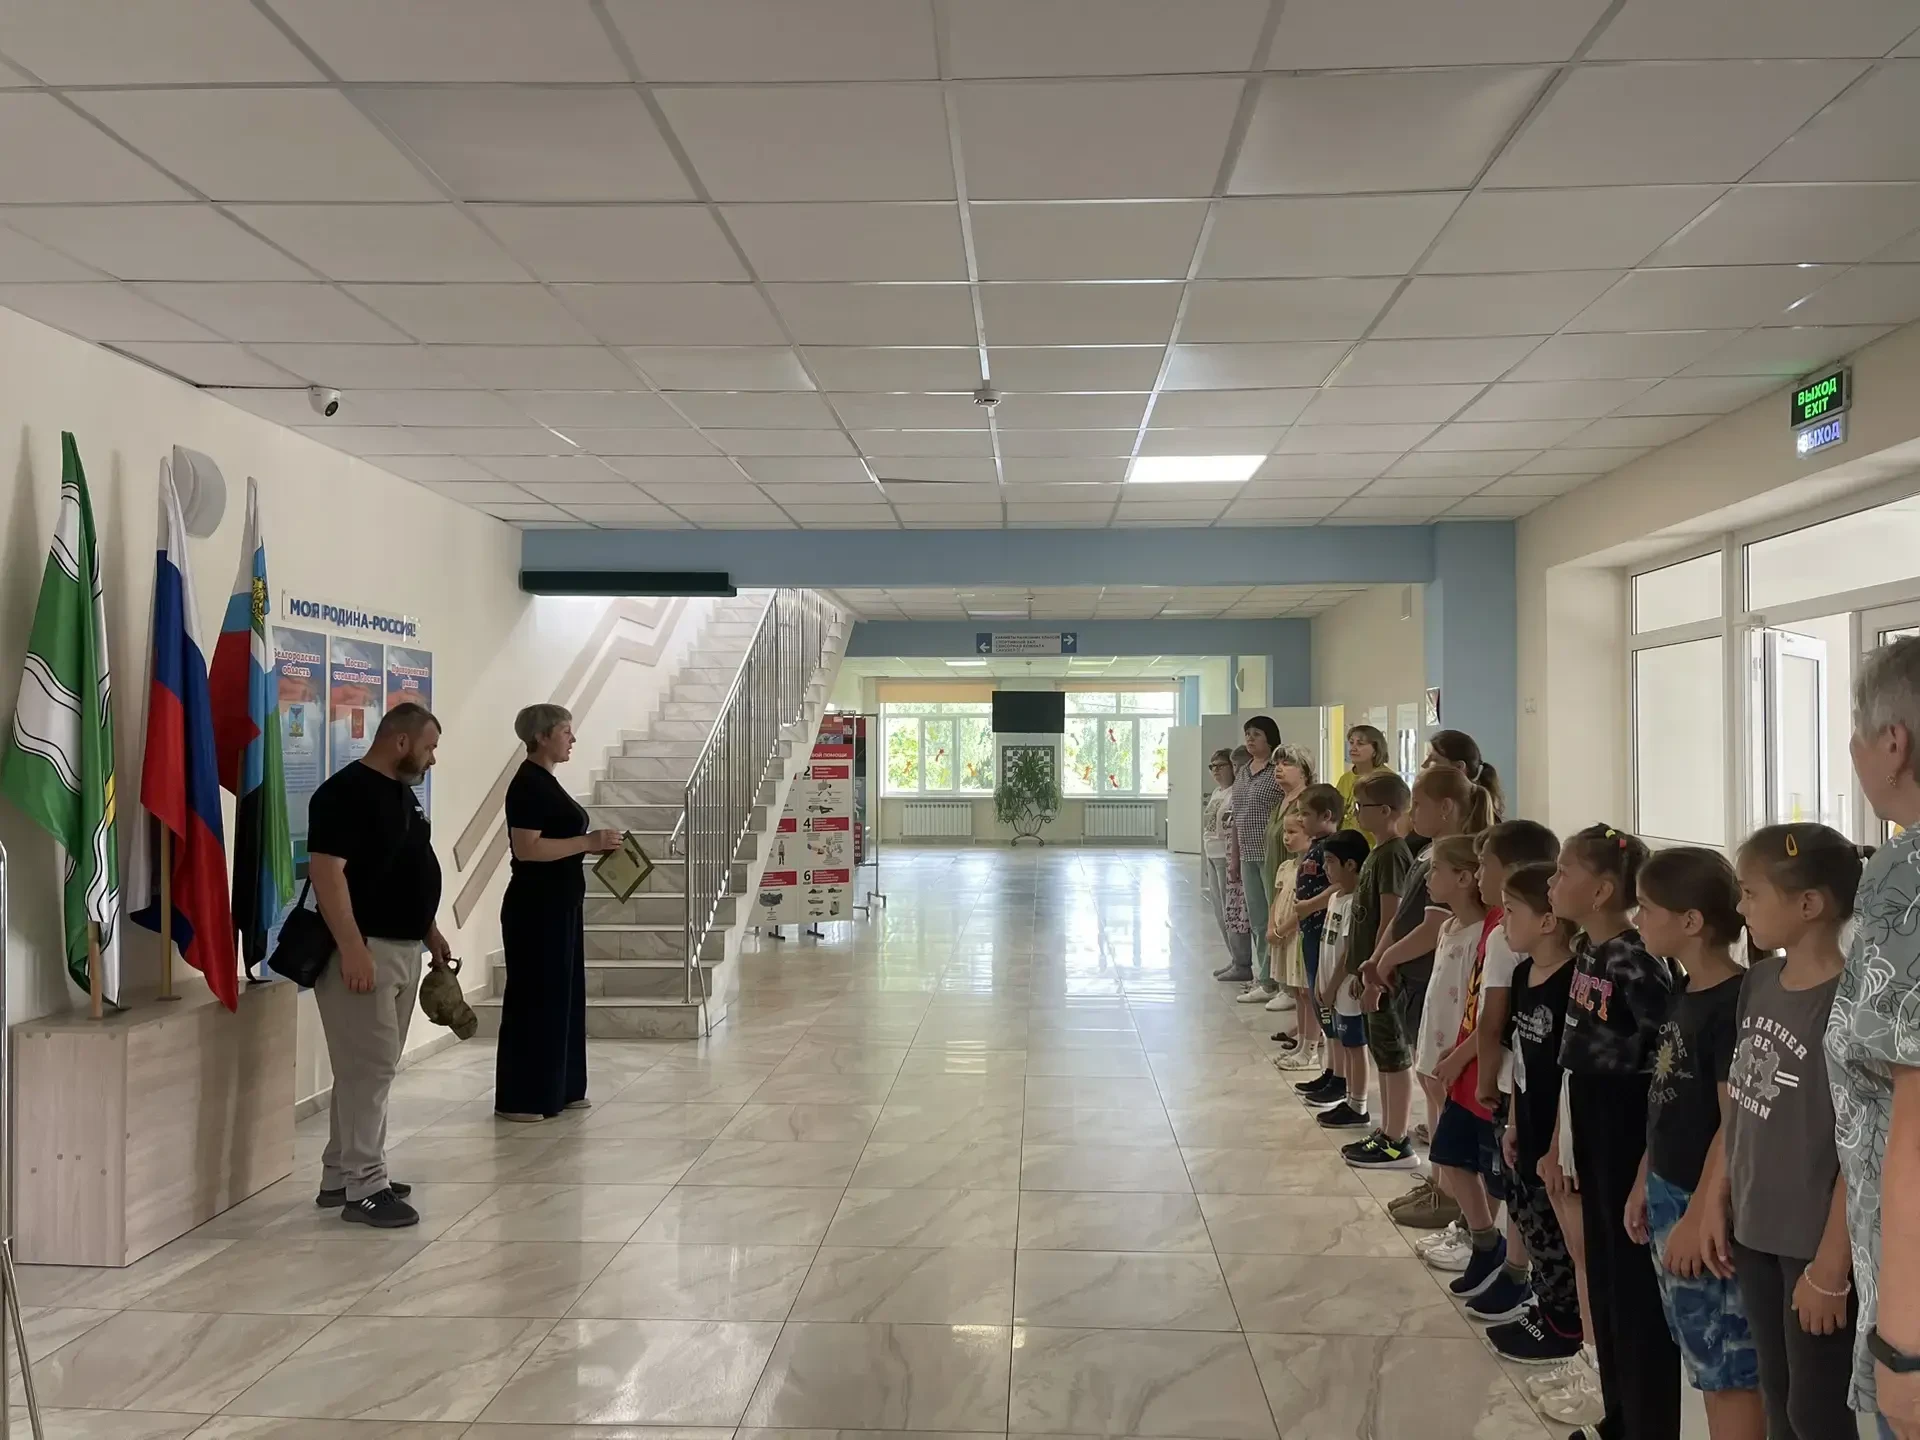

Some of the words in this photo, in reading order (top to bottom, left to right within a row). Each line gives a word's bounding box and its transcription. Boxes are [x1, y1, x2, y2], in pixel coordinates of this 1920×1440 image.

[1798, 377, 1837, 406] ВЫХОД
[1804, 397, 1829, 419] EXIT
[1798, 421, 1840, 453] ВЫХОД
[290, 598, 320, 619] МОЯ
[282, 663, 311, 678] область
[804, 766, 811, 776] 2
[803, 818, 811, 828] 4
[803, 870, 811, 881] 6
[1753, 1034, 1771, 1052] BE
[1756, 1016, 1808, 1060] RATHER
[1745, 1073, 1752, 1088] A
